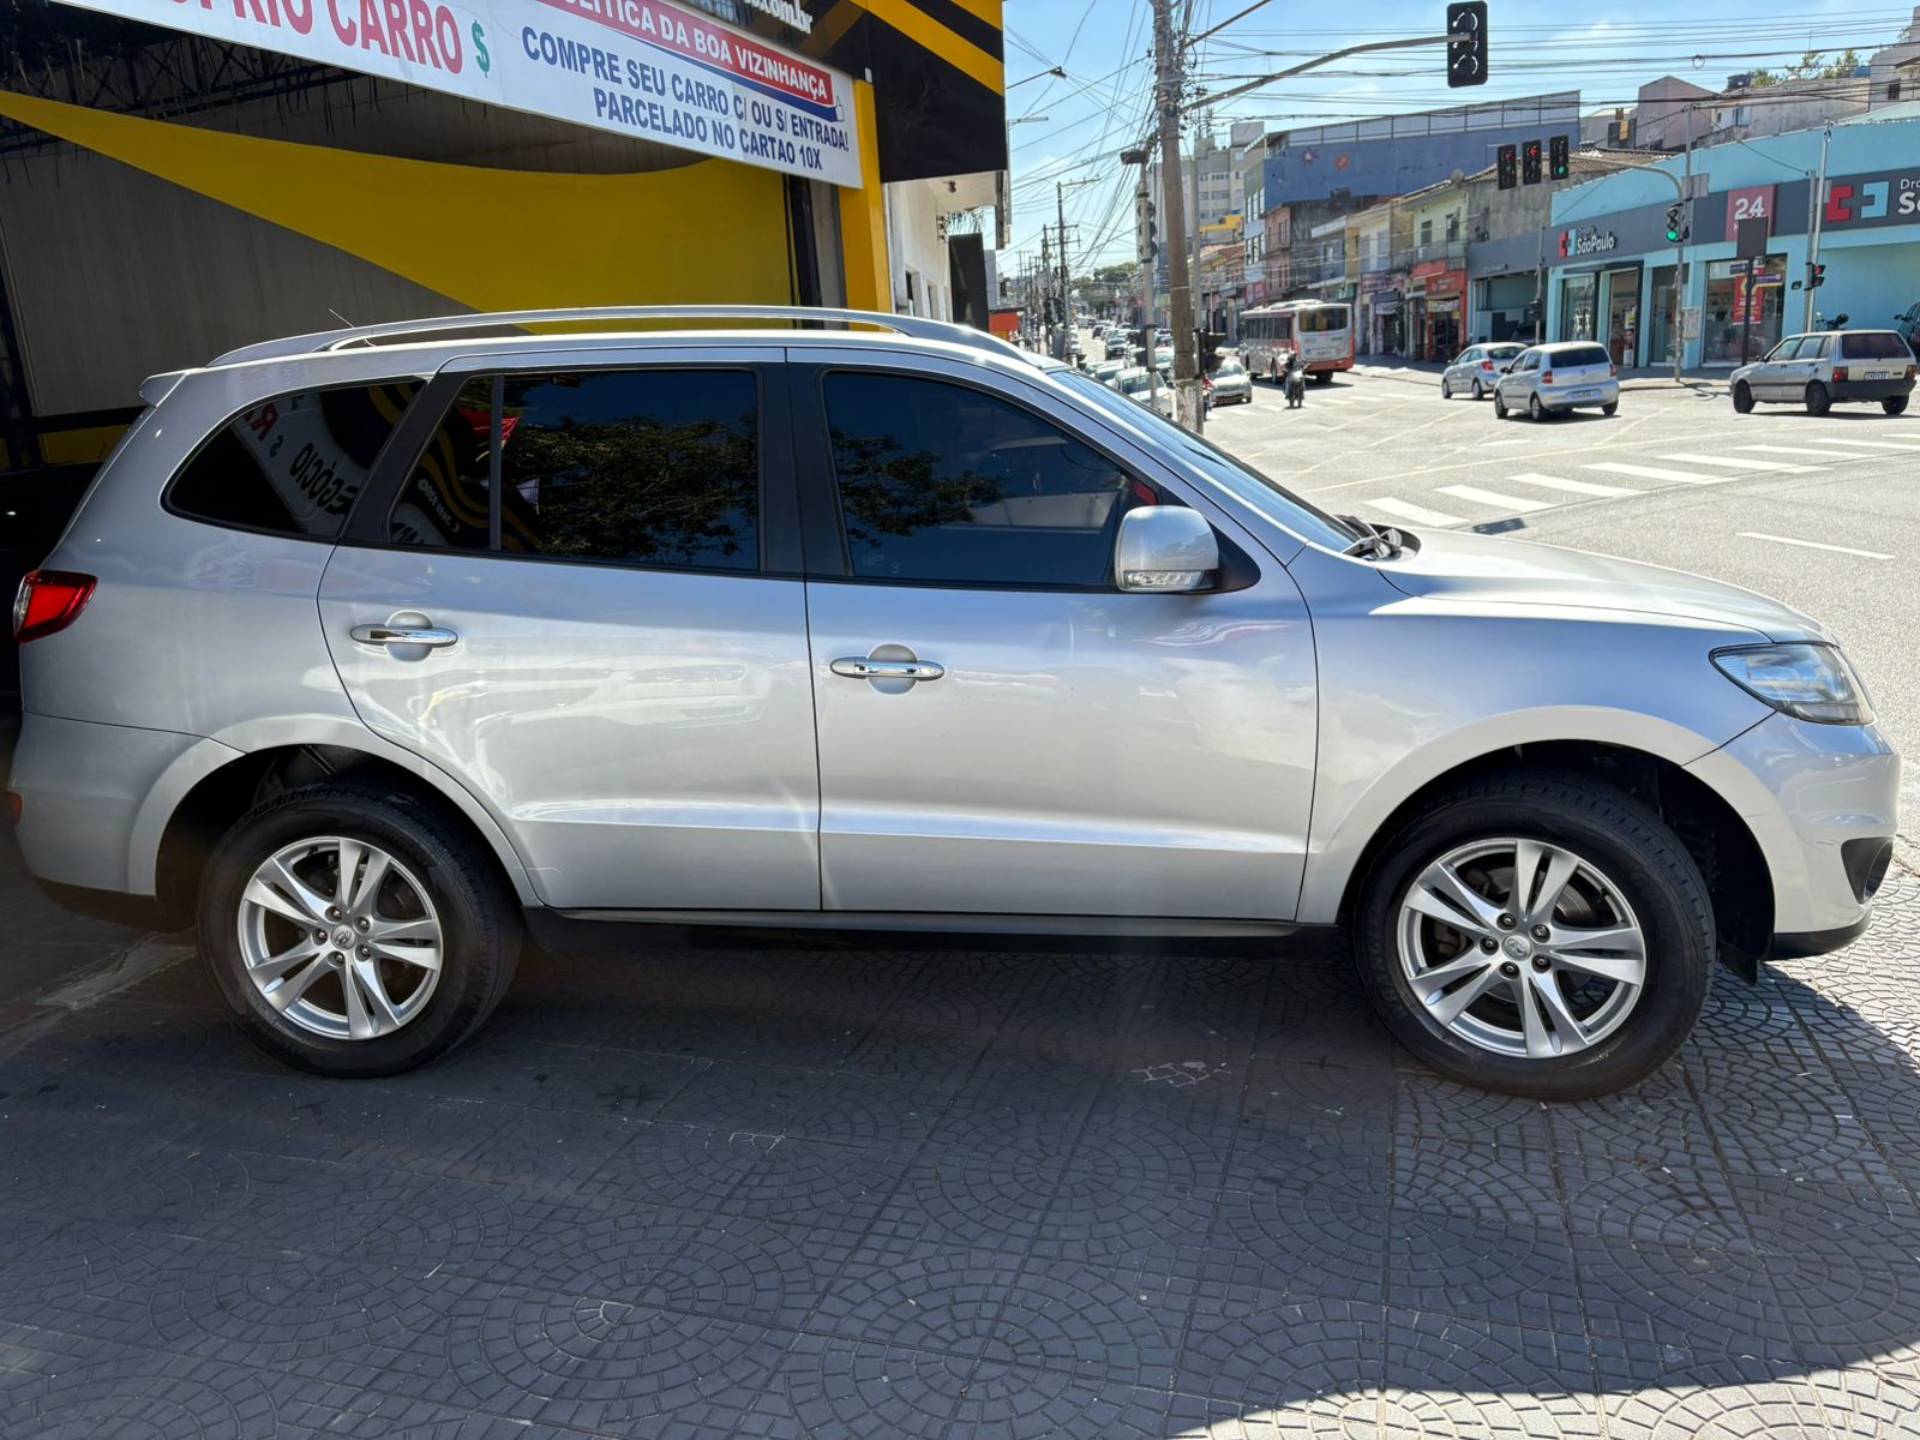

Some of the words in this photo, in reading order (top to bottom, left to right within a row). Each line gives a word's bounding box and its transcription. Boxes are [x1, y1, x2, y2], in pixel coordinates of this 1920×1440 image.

[328, 0, 464, 74] CARRO
[659, 14, 690, 48] DA
[694, 28, 733, 65] BOA
[735, 45, 828, 100] VIZINHANÇA
[521, 26, 622, 84] COMPRE
[626, 59, 666, 97] SEU
[671, 73, 728, 116] CARRO
[733, 94, 747, 122] C/
[751, 100, 772, 128] OU
[775, 108, 788, 134] S/
[791, 114, 850, 152] ENTRADA!
[593, 87, 707, 143] PARCELADO
[712, 120, 735, 150] NO
[739, 128, 796, 164] CARTAO
[800, 145, 823, 170] 10X
[1734, 195, 1765, 220] 24
[1897, 191, 1920, 215] S
